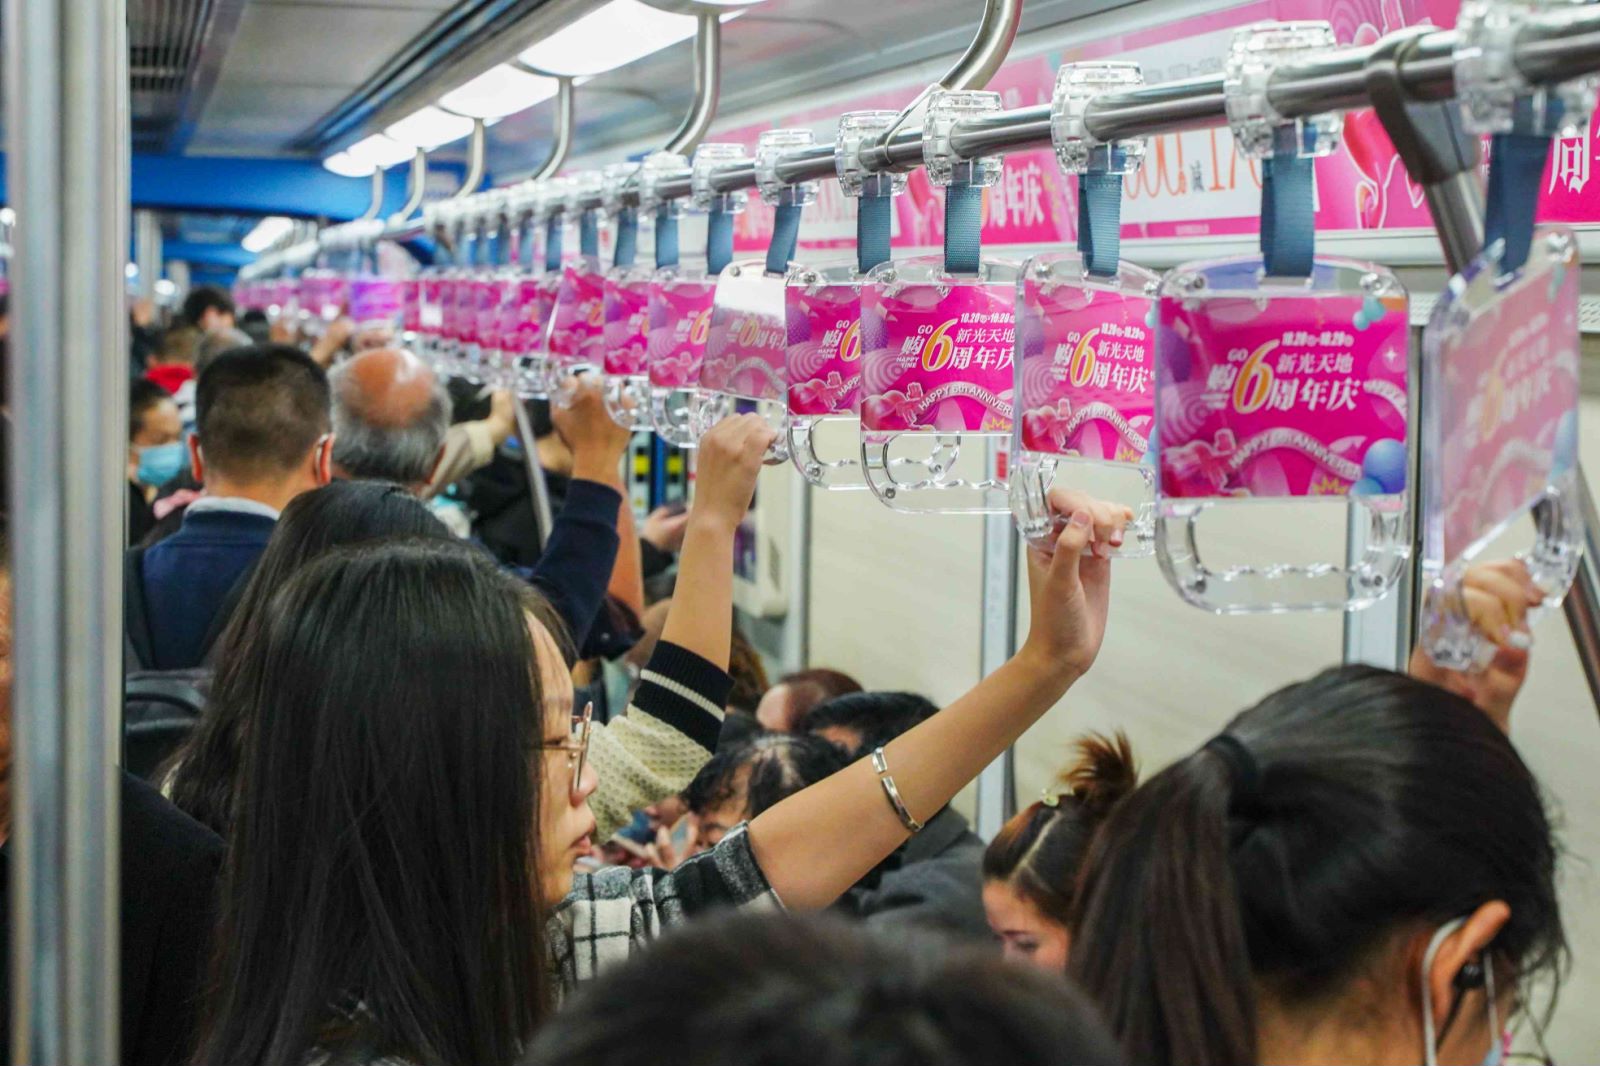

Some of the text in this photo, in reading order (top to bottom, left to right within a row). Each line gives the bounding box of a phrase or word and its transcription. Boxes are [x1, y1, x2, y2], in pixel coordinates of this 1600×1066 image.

[917, 325, 934, 335] GO
[956, 328, 1015, 344] 新光天地
[1067, 331, 1081, 343] GO
[922, 318, 959, 372] 6
[1097, 339, 1145, 363] 新光天地
[1227, 347, 1249, 362] GO
[1070, 327, 1100, 388] 6
[1276, 351, 1354, 374] 新光天地
[837, 376, 861, 397] HAPP
[1089, 360, 1149, 394] 周年庆
[1232, 338, 1281, 414] 6
[918, 386, 951, 412] HAPPY
[1266, 377, 1361, 412] 周年庆
